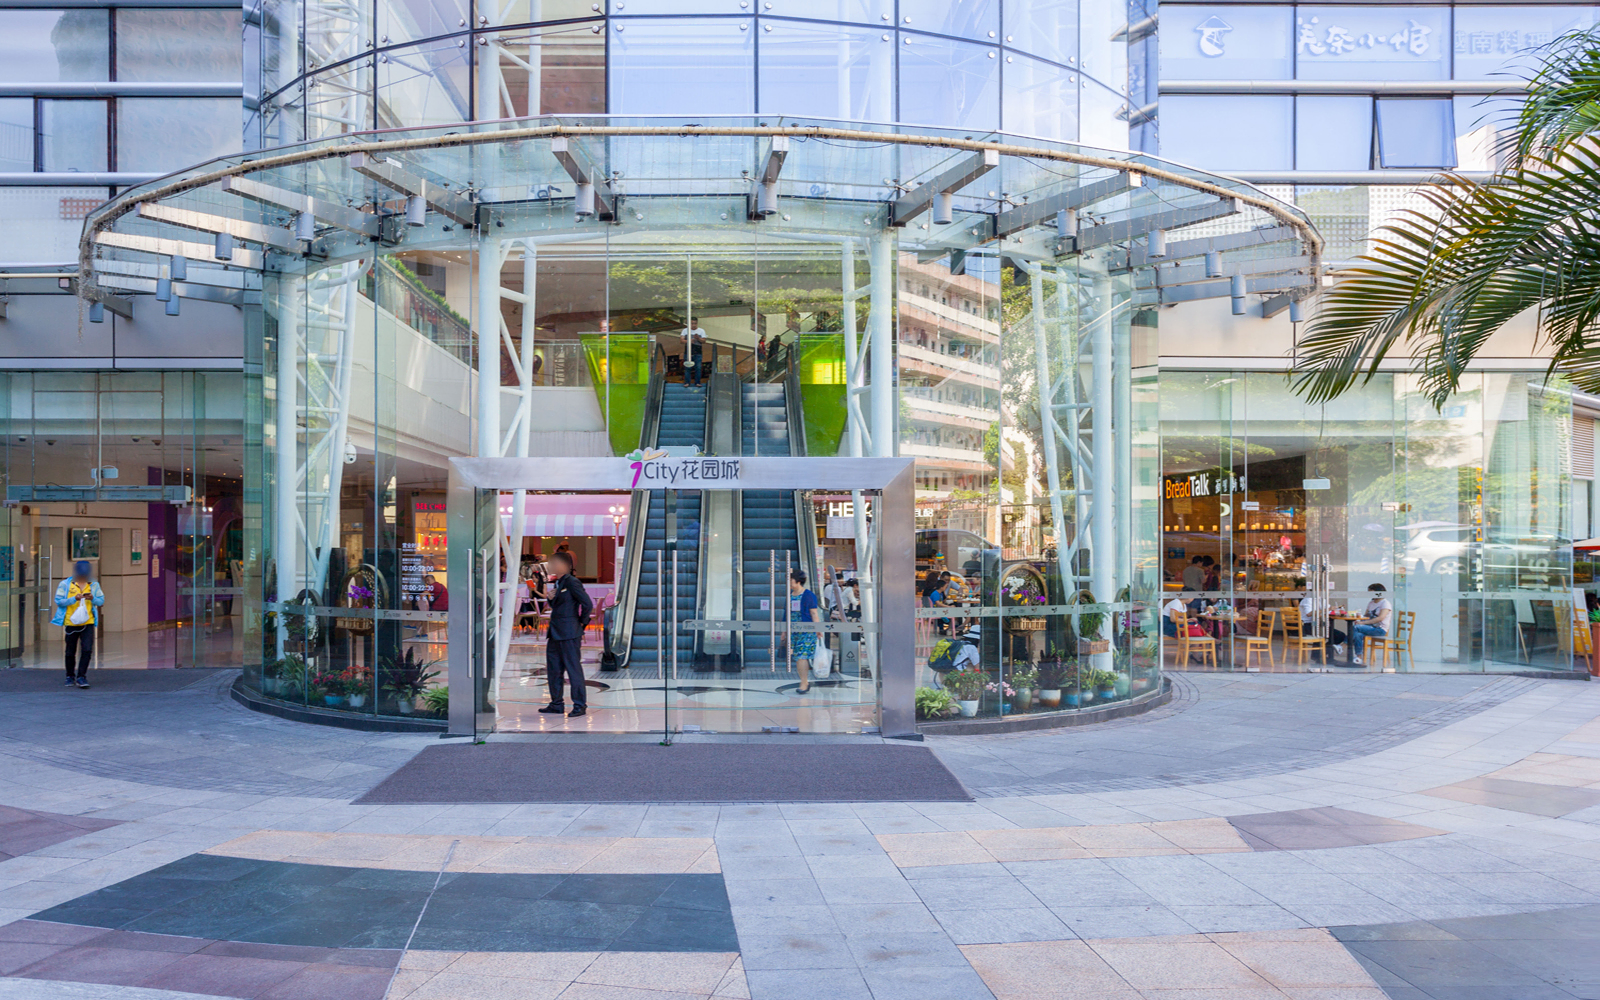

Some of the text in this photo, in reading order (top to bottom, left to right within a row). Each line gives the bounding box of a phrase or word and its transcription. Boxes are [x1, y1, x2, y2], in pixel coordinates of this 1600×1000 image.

[682, 459, 740, 480] 花园城
[1165, 472, 1210, 499] BreadTalk
